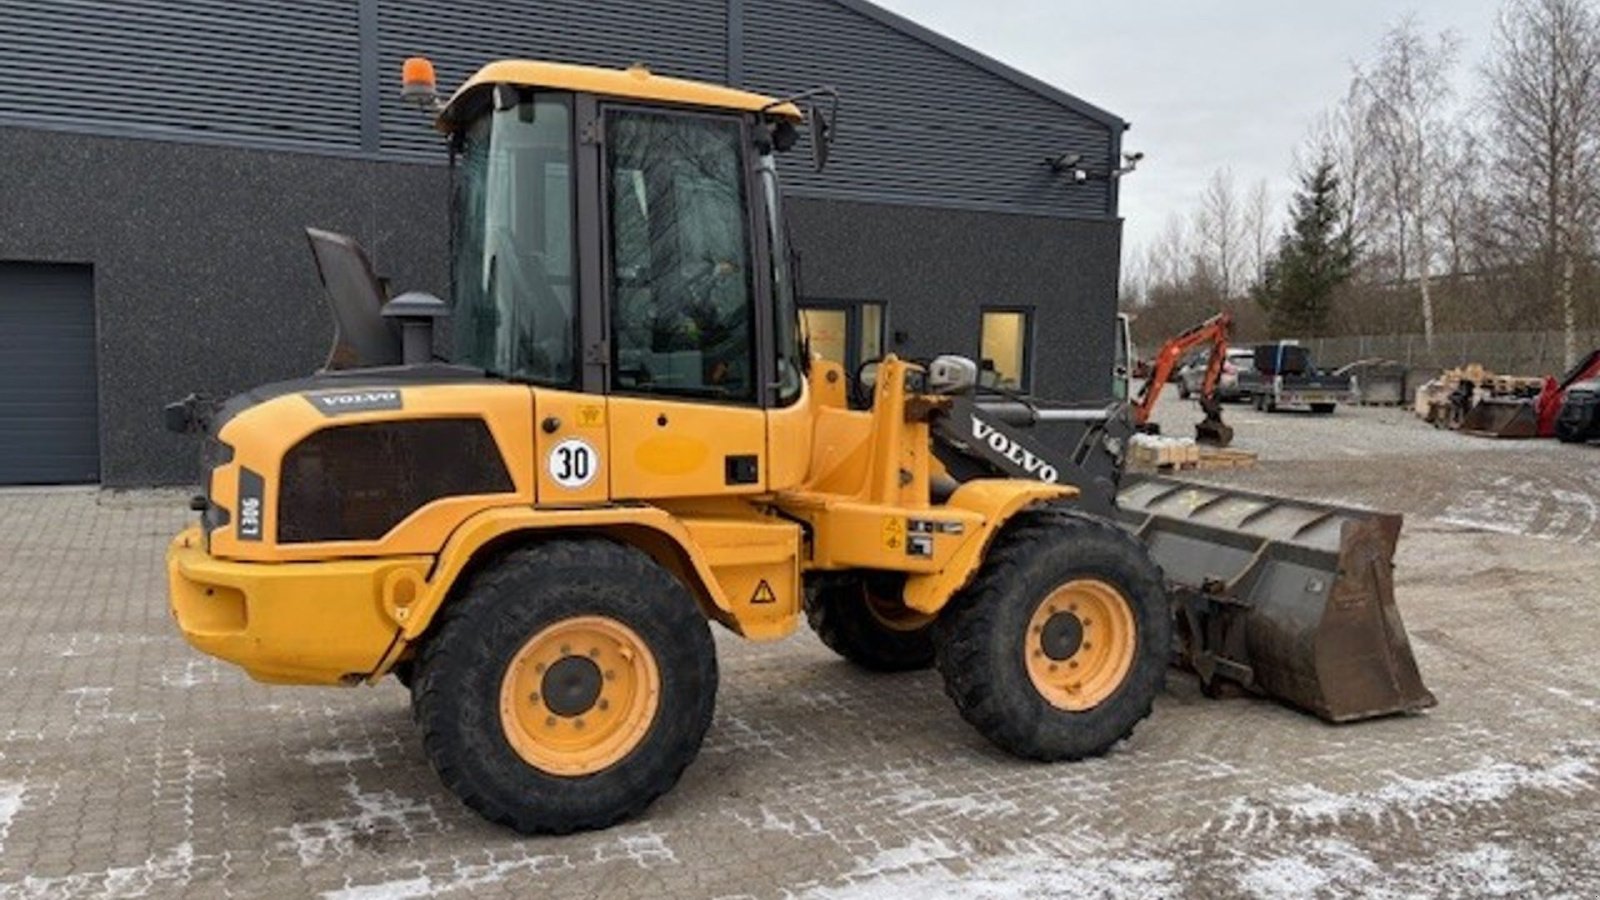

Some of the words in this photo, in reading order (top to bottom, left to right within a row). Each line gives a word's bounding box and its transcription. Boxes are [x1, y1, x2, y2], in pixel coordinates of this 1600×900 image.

[322, 391, 397, 405] VOLVO
[557, 447, 588, 480] 30
[970, 414, 1058, 484] VOLVO
